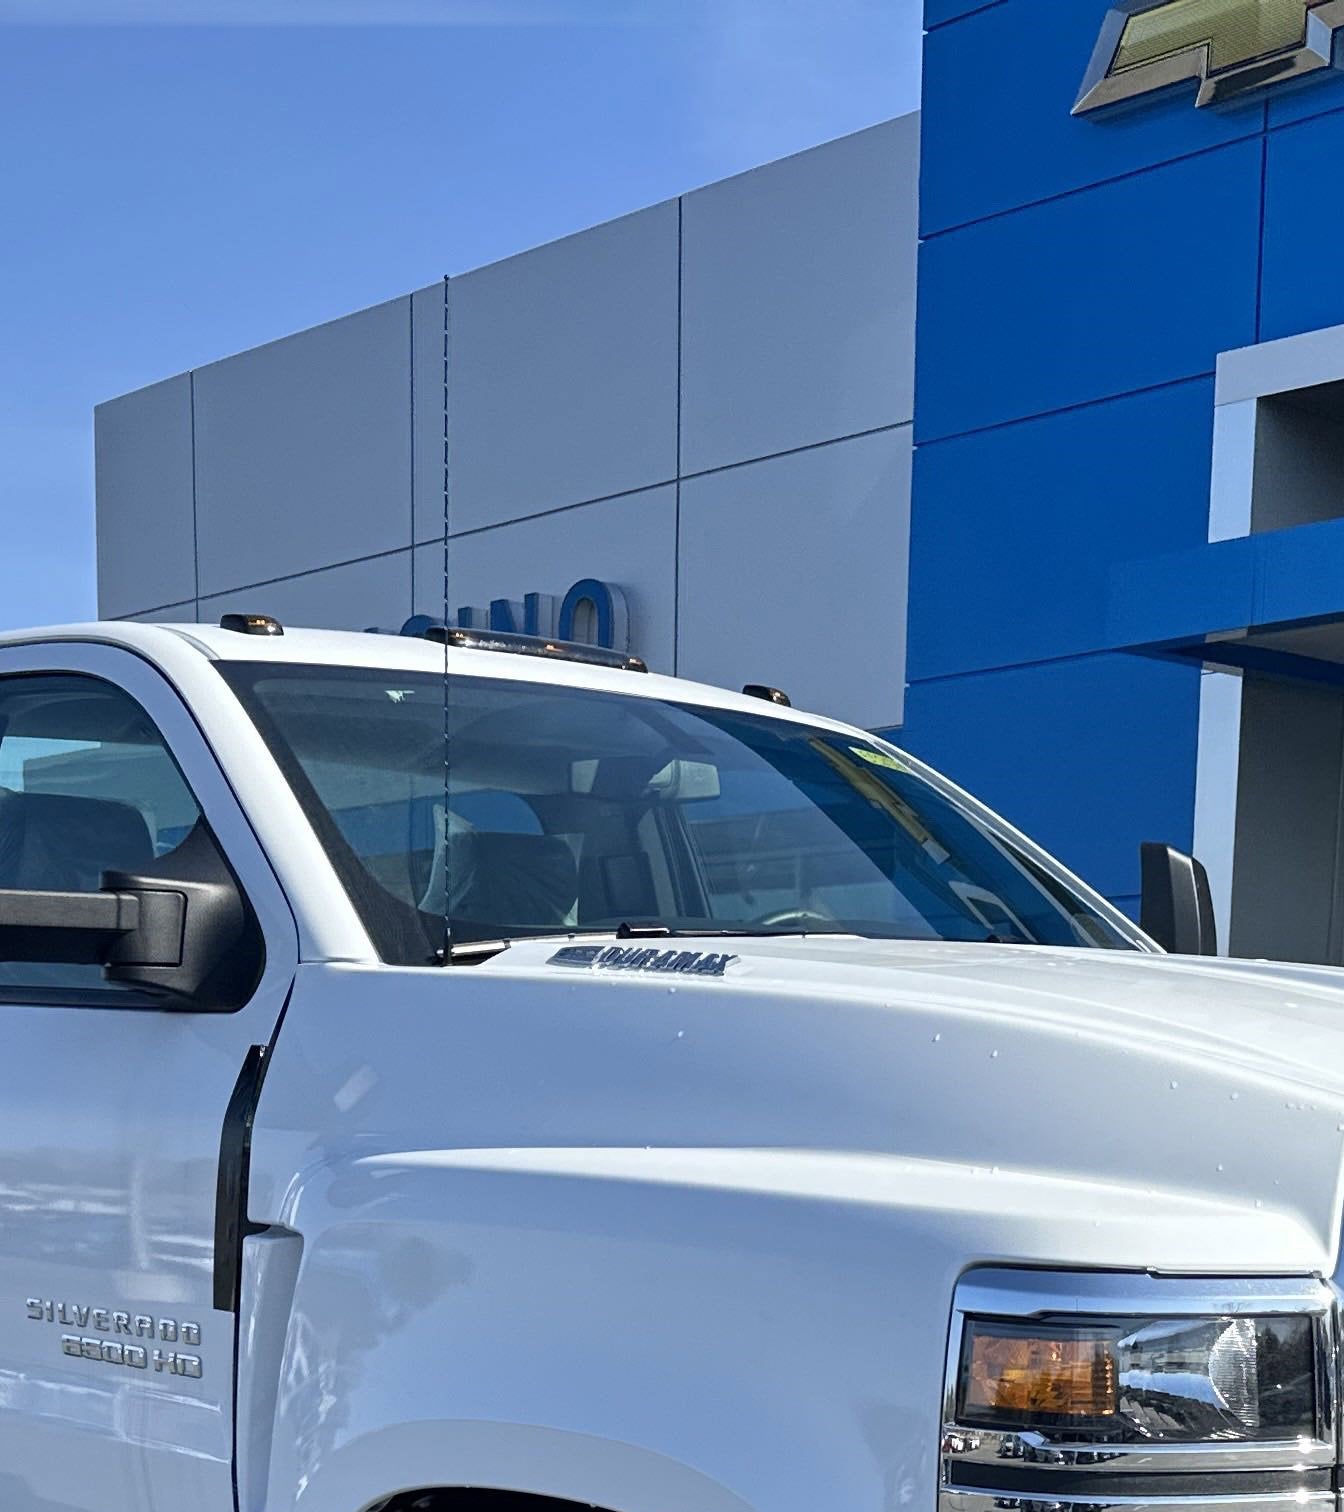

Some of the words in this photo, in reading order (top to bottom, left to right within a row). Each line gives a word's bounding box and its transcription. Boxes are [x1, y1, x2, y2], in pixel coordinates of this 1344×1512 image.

[596, 945, 738, 976] DURAMAX
[26, 1298, 202, 1346] SILVERADO
[153, 1349, 202, 1379] HD
